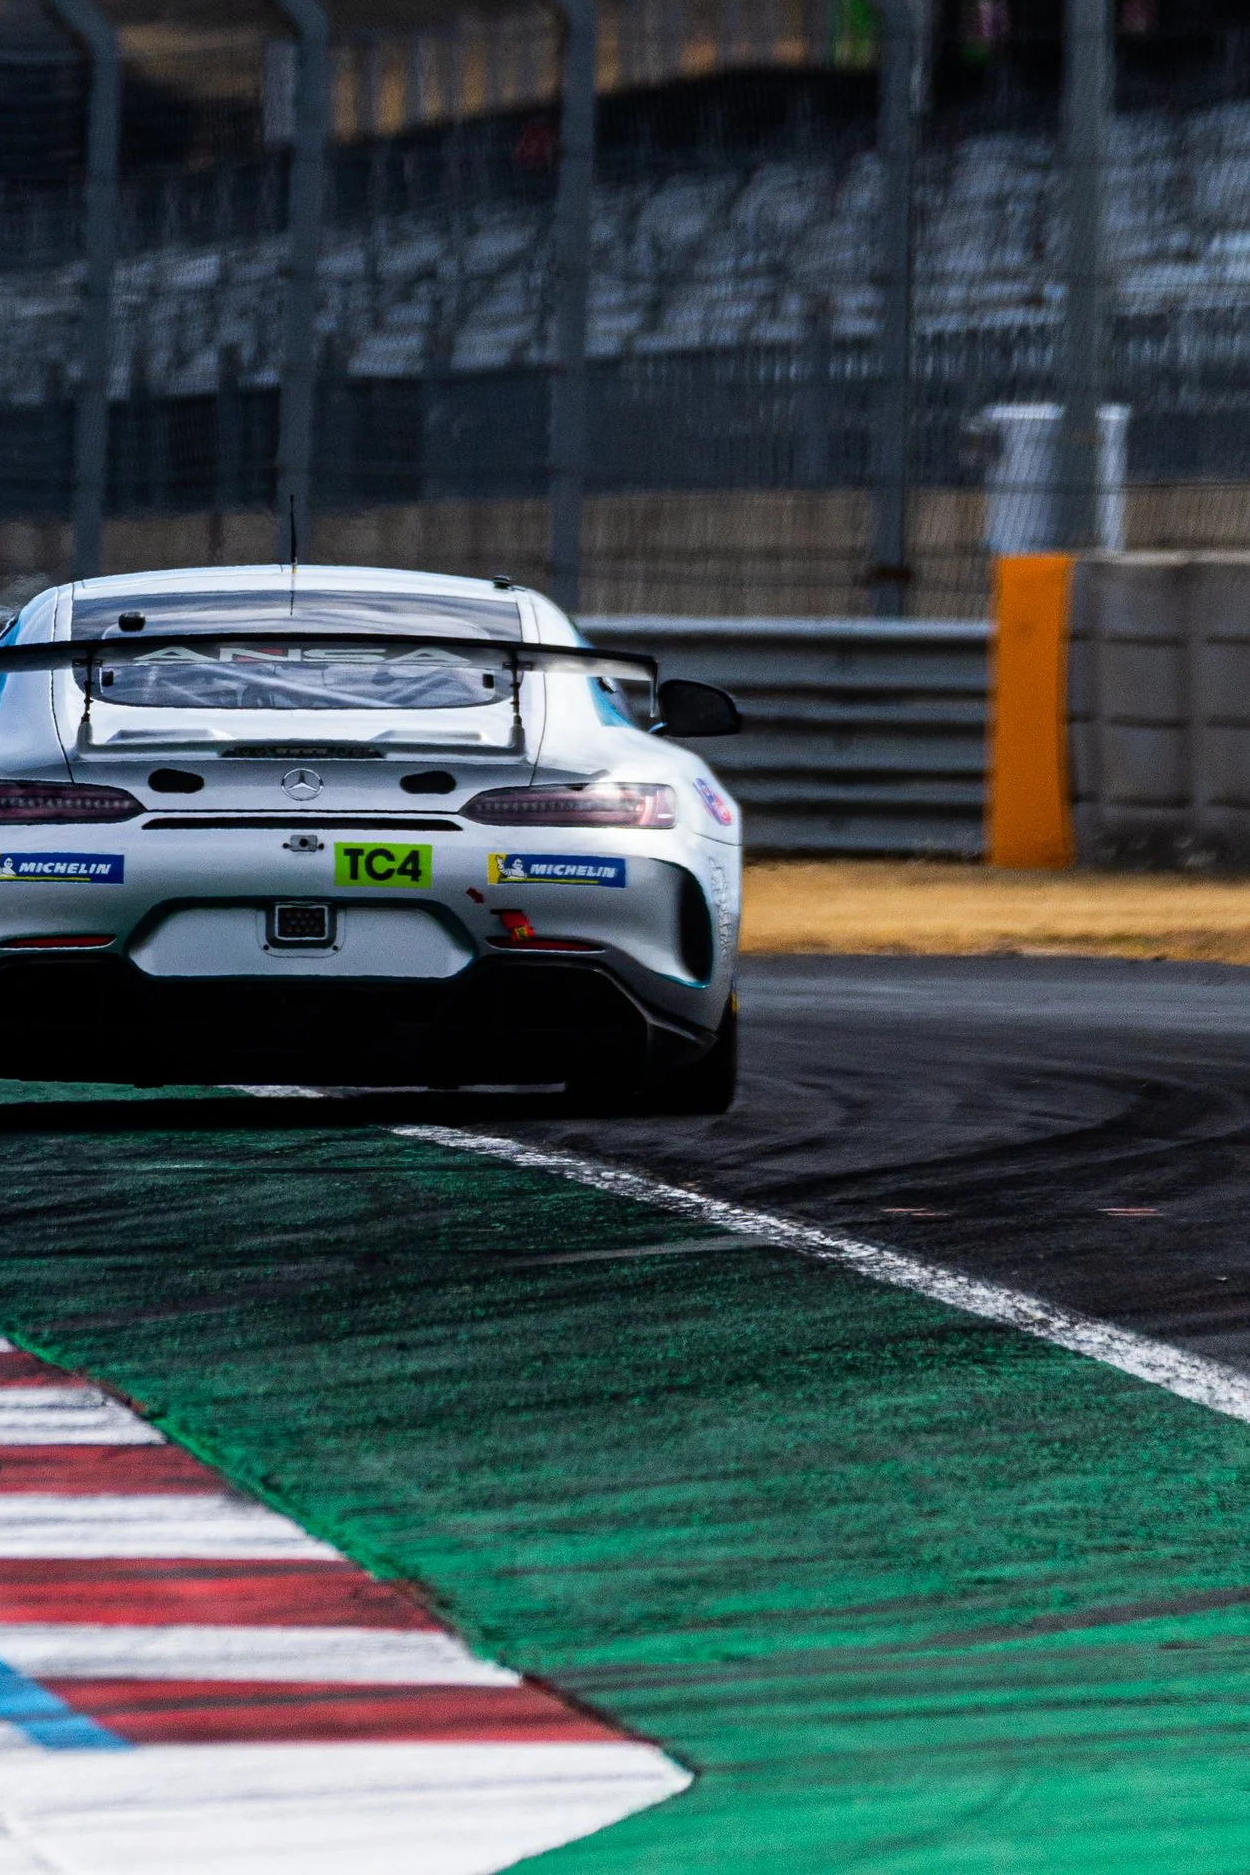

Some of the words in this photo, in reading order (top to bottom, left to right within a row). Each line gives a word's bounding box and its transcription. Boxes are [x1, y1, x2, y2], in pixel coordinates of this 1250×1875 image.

[134, 646, 471, 666] ANSA
[19, 862, 111, 875] MICHELIN
[343, 848, 422, 882] TC4
[530, 863, 616, 878] MICHELIN
